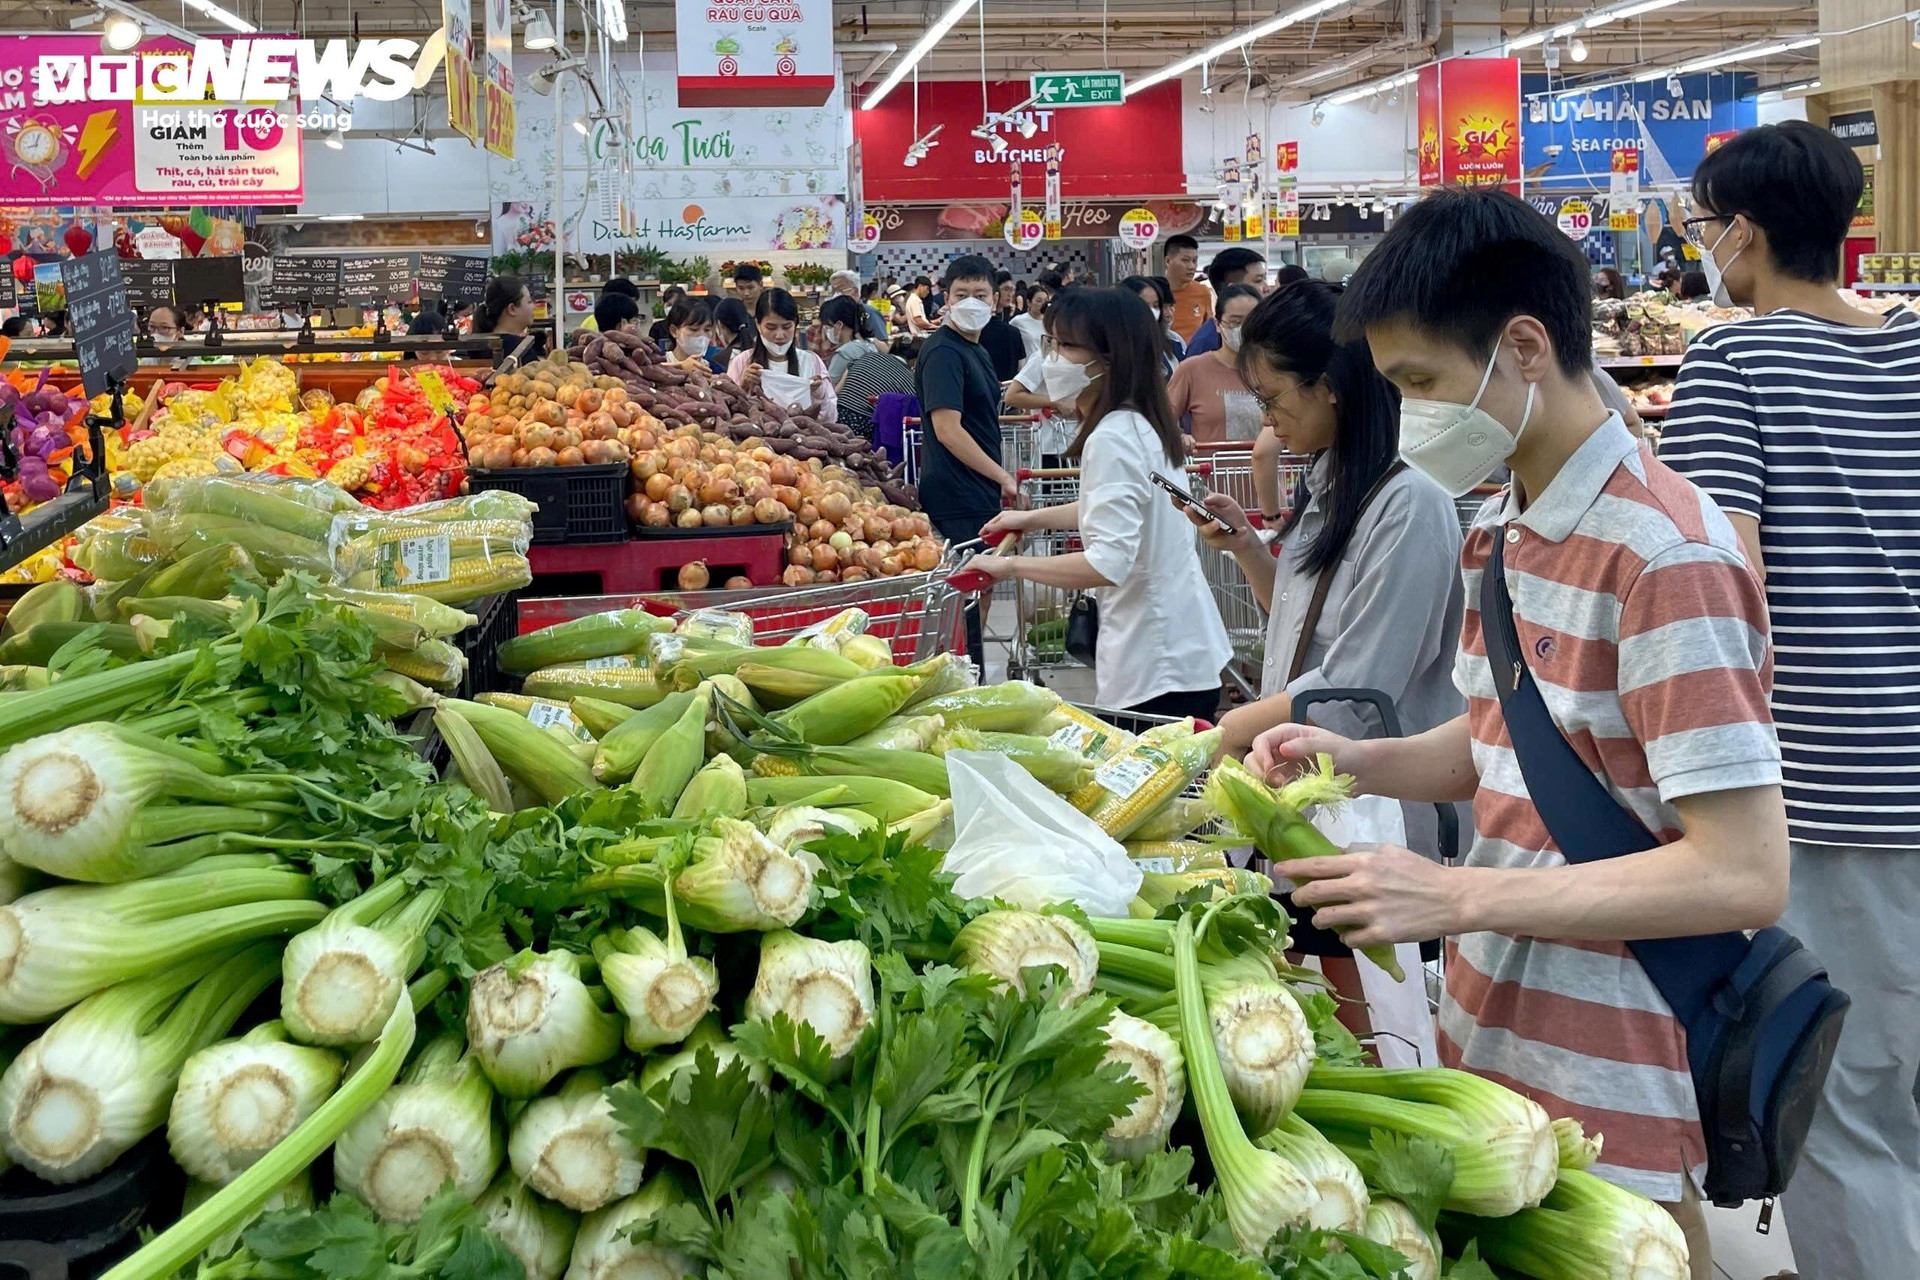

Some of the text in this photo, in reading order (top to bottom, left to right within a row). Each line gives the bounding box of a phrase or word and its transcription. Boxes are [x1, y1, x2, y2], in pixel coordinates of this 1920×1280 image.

[708, 5, 801, 21] RAU CỦ QUẢ
[1091, 90, 1113, 99] EXIT
[150, 121, 207, 139] GIẢM
[672, 119, 735, 166] Tươi
[1465, 130, 1498, 147] GIÁ
[1572, 138, 1647, 151] SEA FOOD
[176, 142, 204, 150] Thêm
[231, 154, 255, 162] phẩm
[156, 168, 184, 178] Thịt,
[186, 167, 203, 177] cá,
[251, 167, 279, 176] tươi,
[171, 178, 263, 188] rau, củ, trái cây
[1062, 202, 1112, 229] Heo
[1571, 214, 1589, 228] 10
[658, 217, 750, 241] Hasfarm
[1134, 223, 1154, 237] 10
